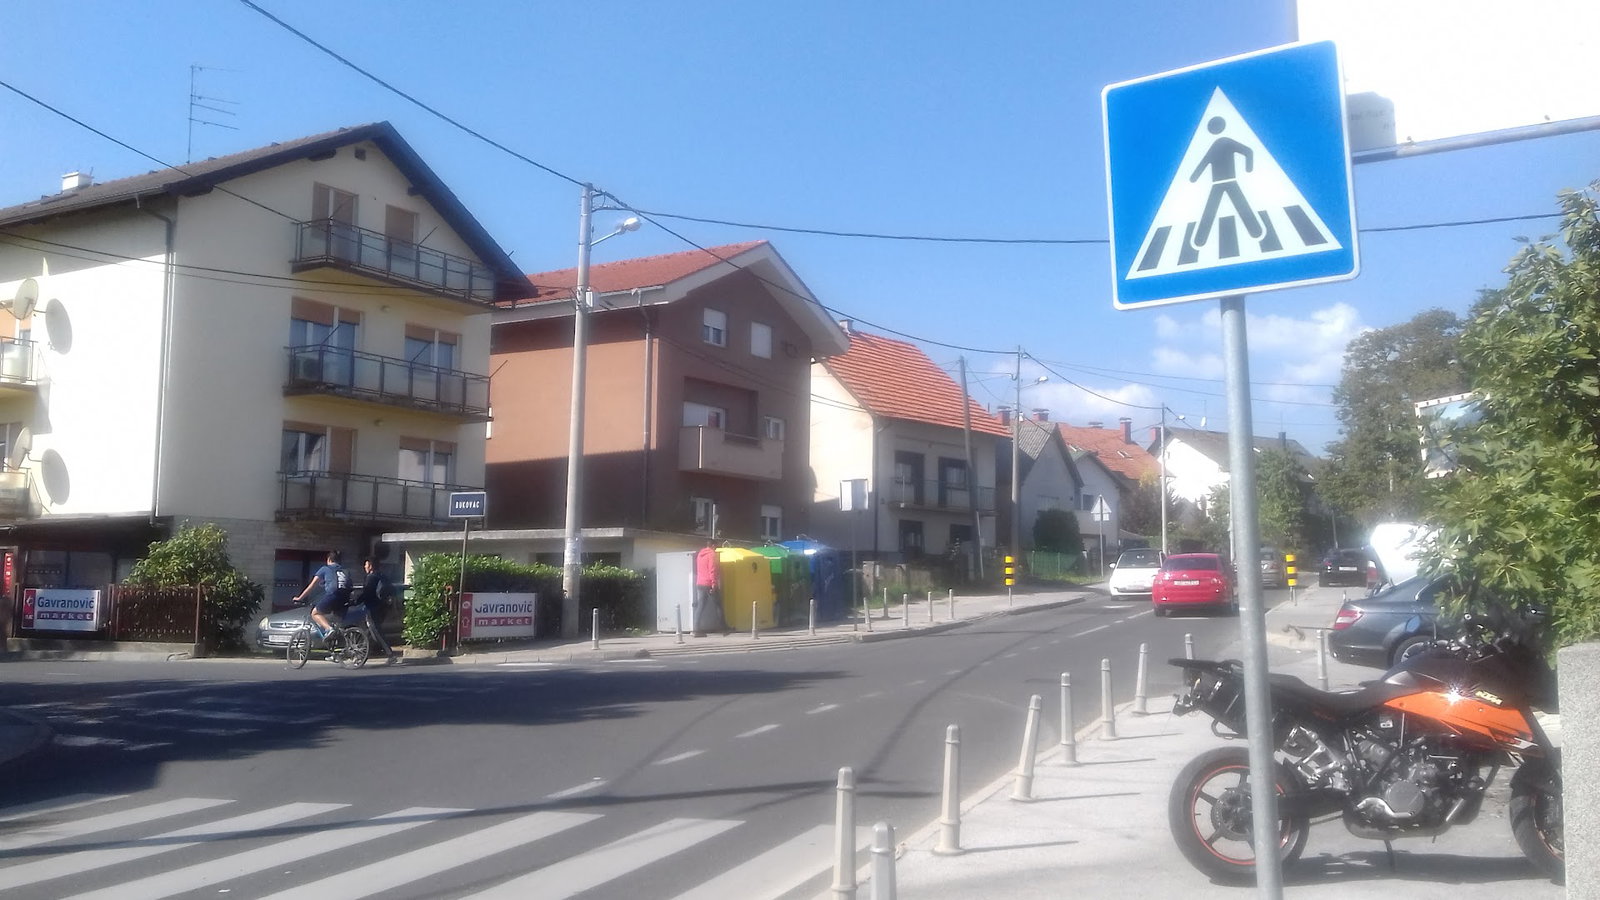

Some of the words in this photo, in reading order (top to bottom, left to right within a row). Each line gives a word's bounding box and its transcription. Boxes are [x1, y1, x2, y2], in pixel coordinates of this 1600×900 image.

[455, 501, 480, 509] BUKOVAC
[37, 597, 94, 609] Gavranović
[40, 612, 92, 620] market
[478, 617, 530, 625] market
